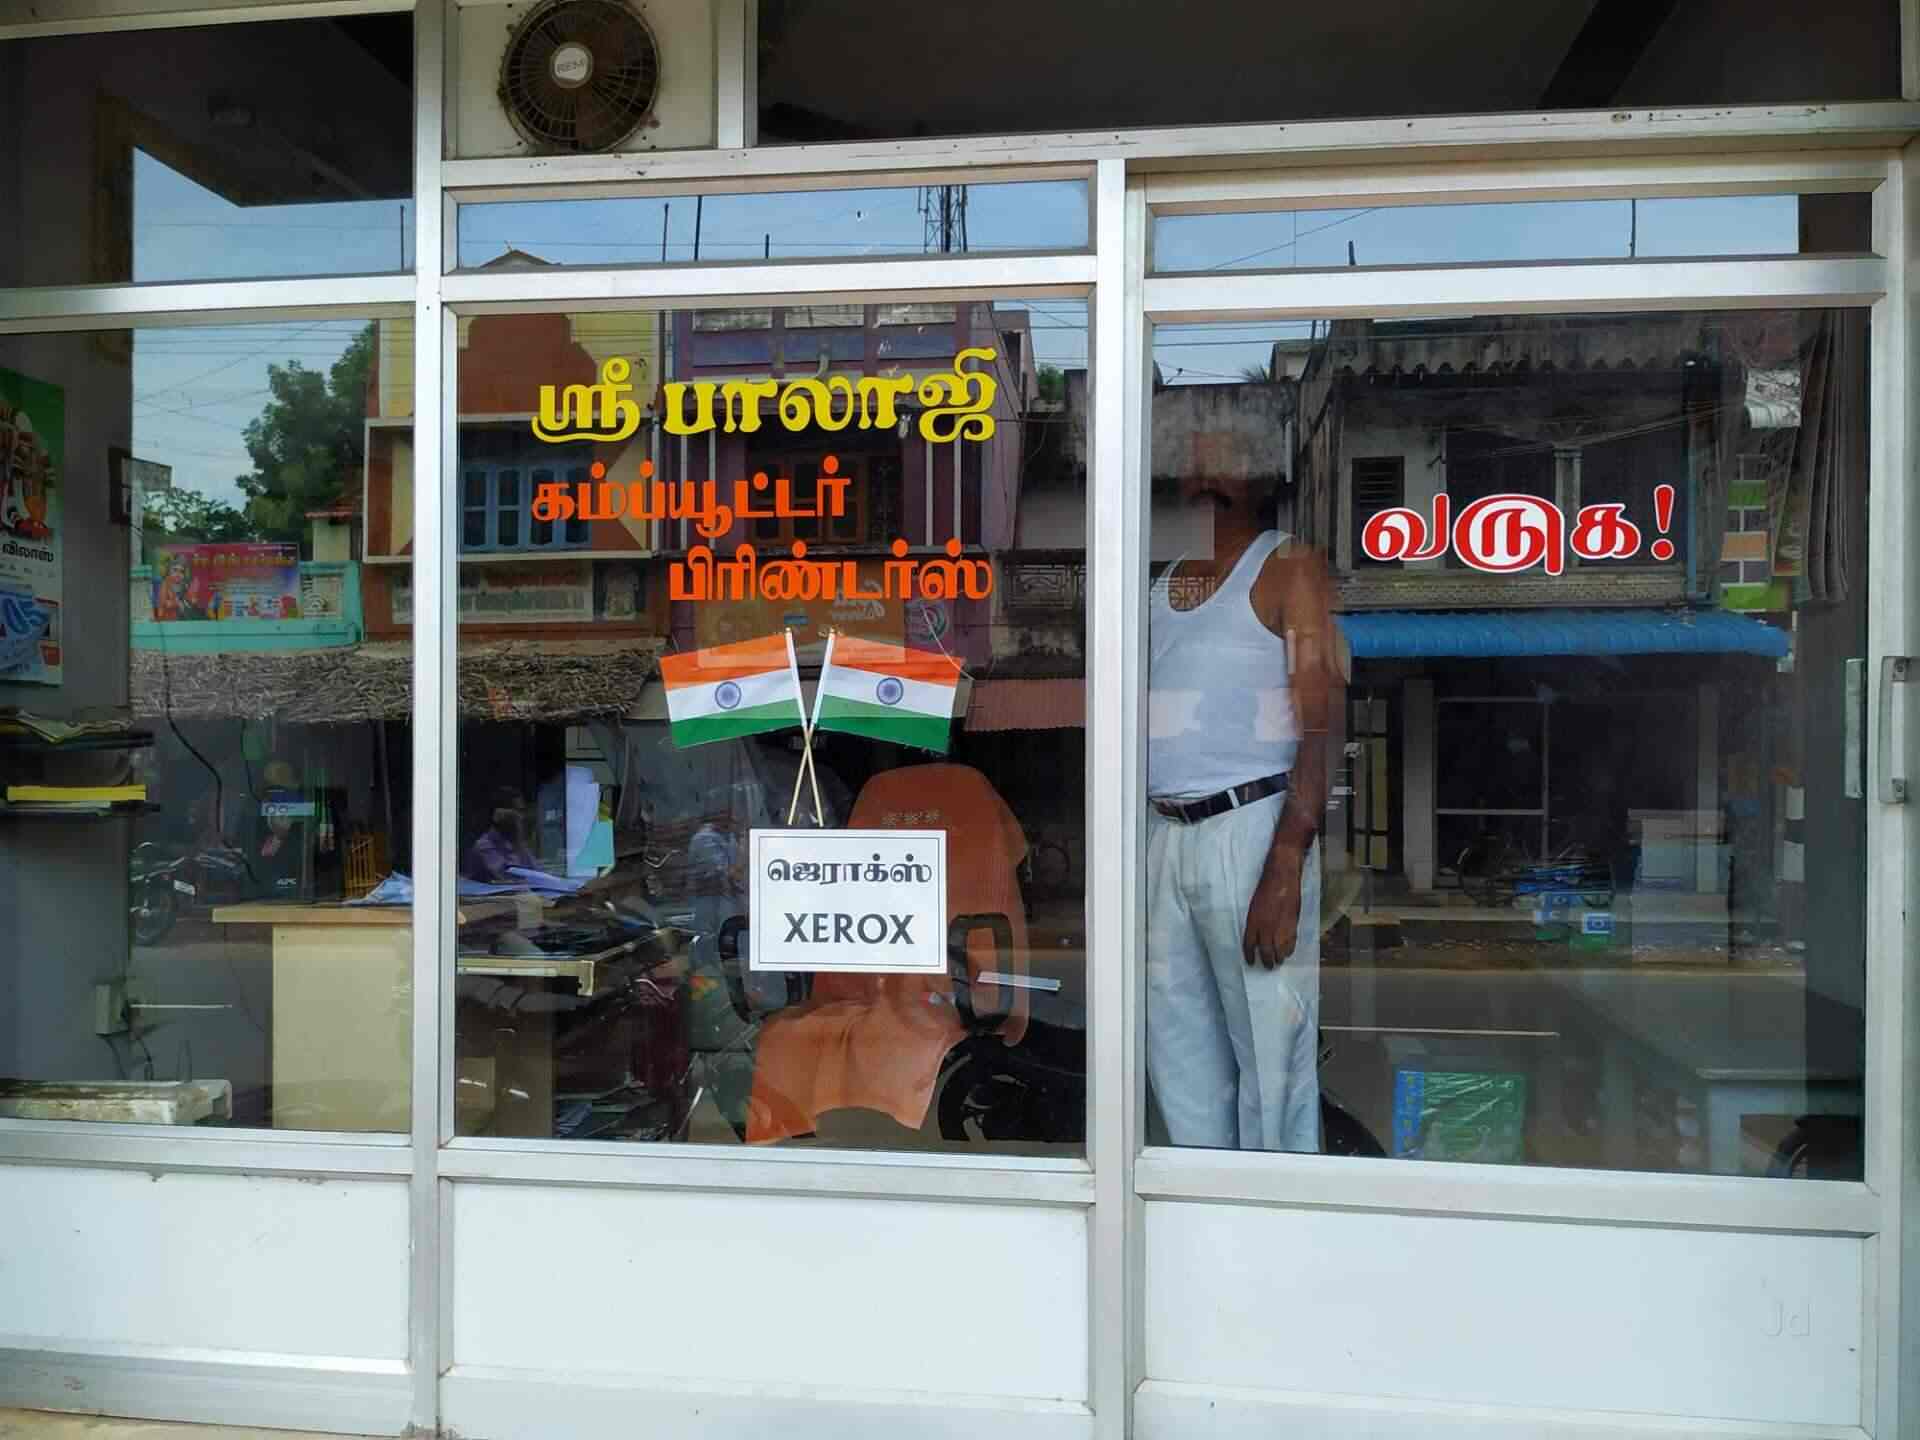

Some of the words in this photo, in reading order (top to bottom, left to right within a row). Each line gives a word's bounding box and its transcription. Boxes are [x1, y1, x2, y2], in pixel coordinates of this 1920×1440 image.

[664, 347, 997, 443] பாலாஜி
[532, 456, 851, 537] கம்ப்யூட்டர்
[669, 538, 993, 601] பிரிண்டர்ஸ்
[767, 853, 932, 885] ஜெராக்ஸ்
[784, 912, 915, 945] XEROX
